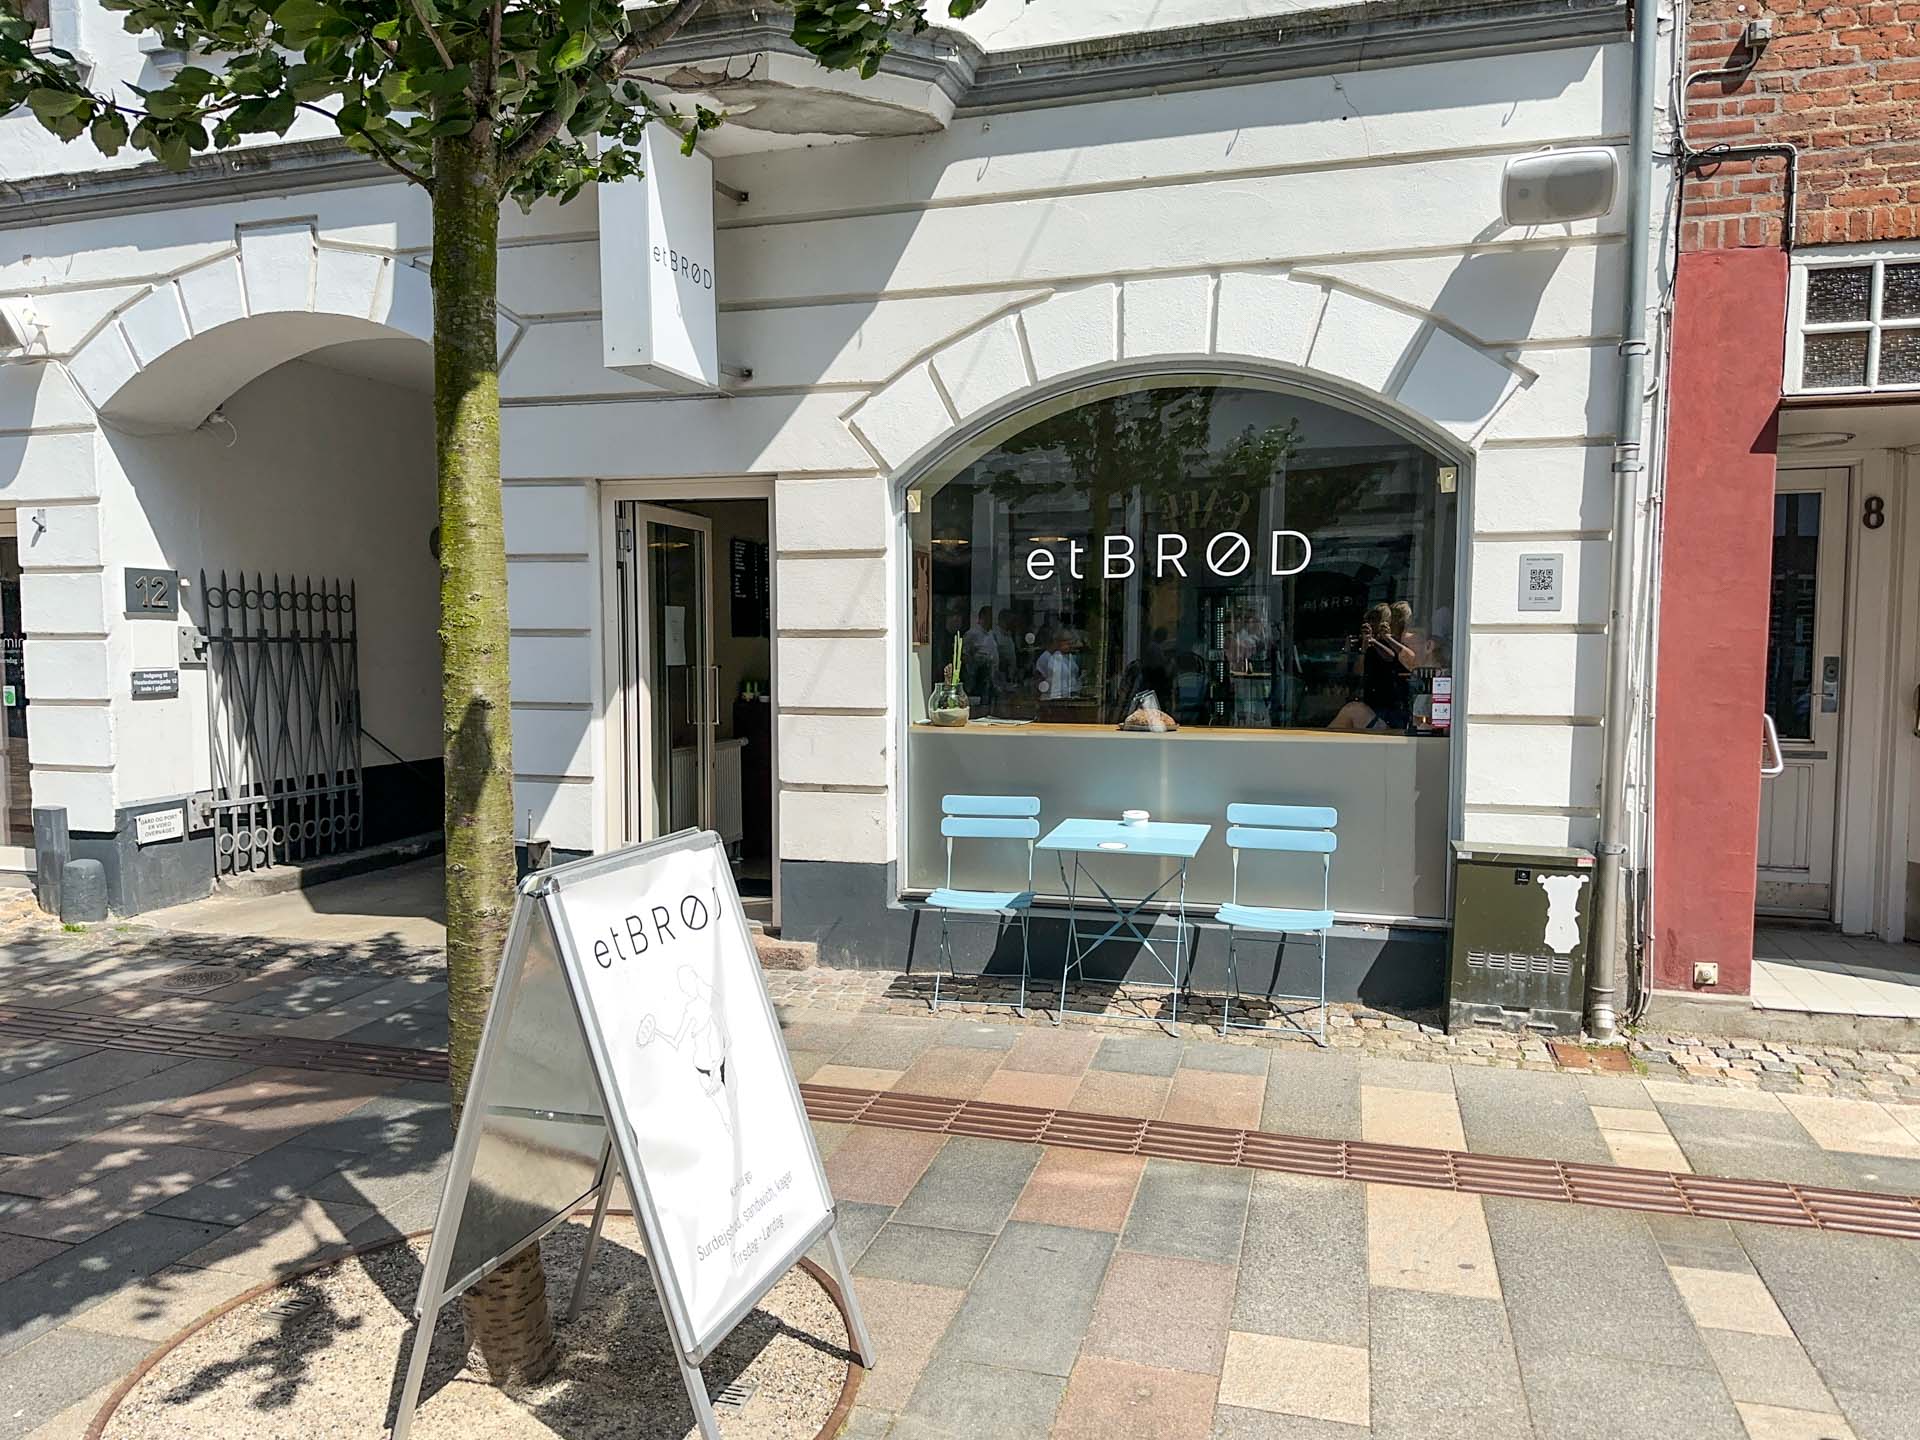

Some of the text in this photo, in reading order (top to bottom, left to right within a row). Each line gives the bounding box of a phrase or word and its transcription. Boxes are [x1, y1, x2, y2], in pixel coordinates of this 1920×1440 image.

[1863, 496, 1884, 529] 8
[1026, 530, 1312, 580] etBRØD
[135, 576, 168, 607] 12
